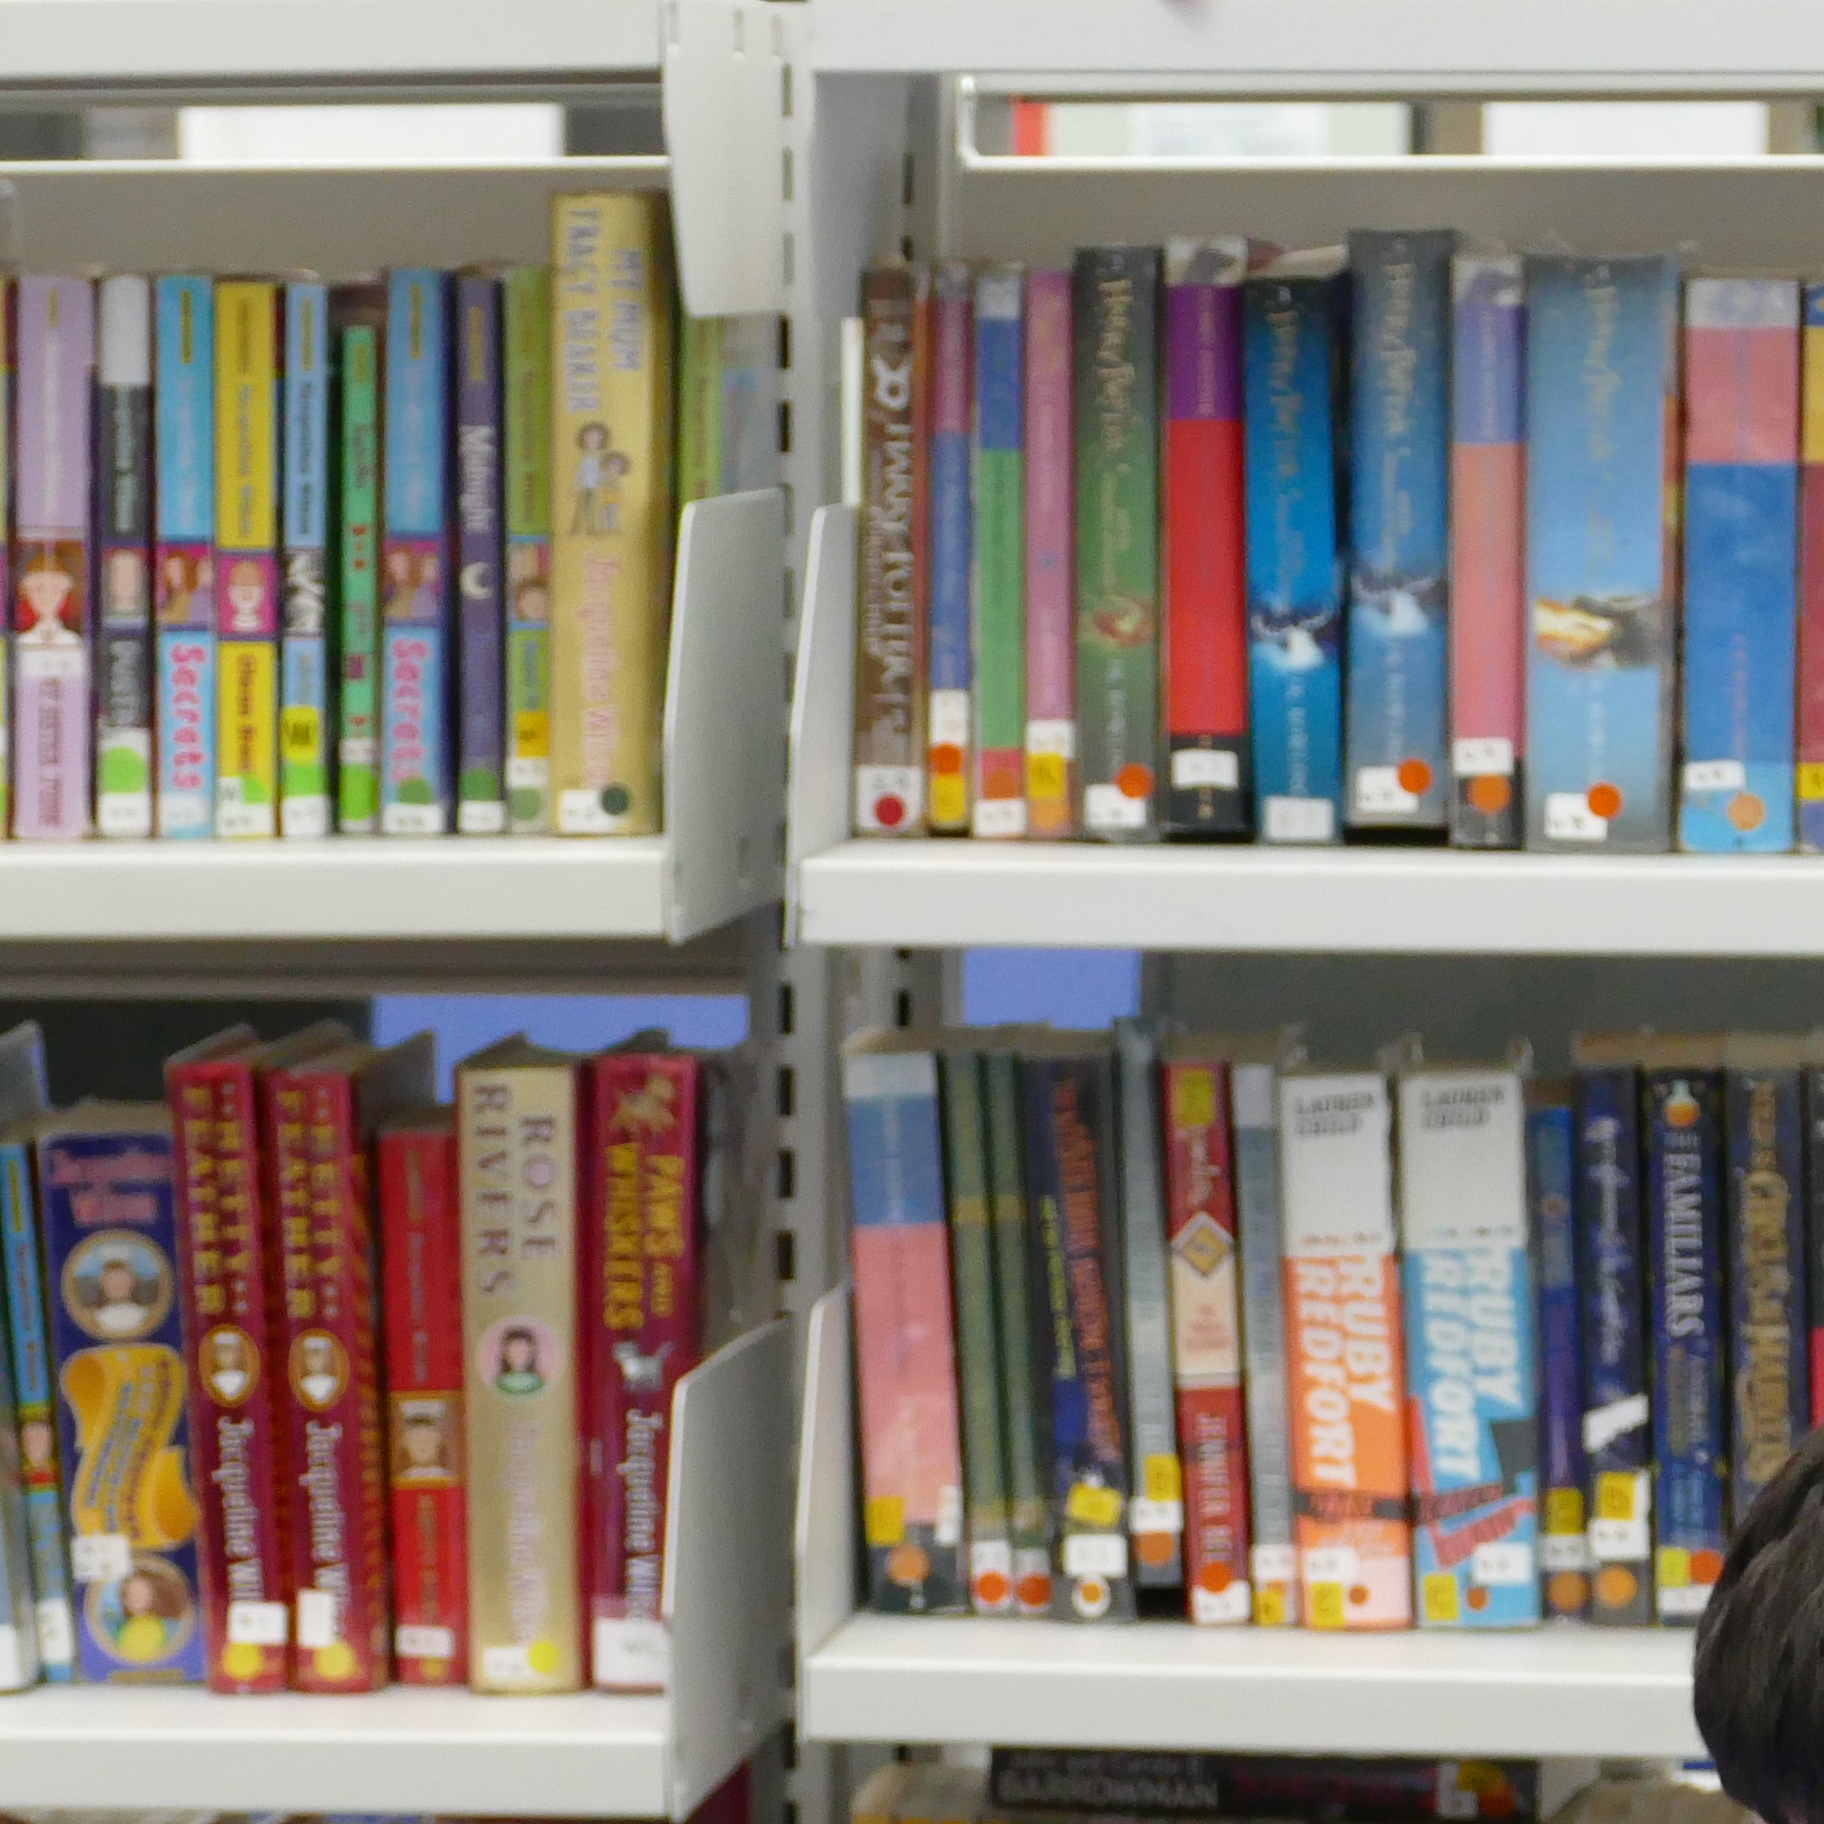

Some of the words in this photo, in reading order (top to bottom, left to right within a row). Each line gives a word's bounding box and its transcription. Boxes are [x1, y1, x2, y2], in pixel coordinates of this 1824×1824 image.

[166, 640, 209, 793] Secrets
[473, 1081, 516, 1298] RIVERS
[1664, 1150, 1707, 1338] FAMILIARS
[1296, 1255, 1356, 1488] REDFORT
[1339, 1255, 1394, 1411] RUBY
[1426, 1254, 1479, 1480] REDFORT
[1479, 1250, 1521, 1404] RUBY
